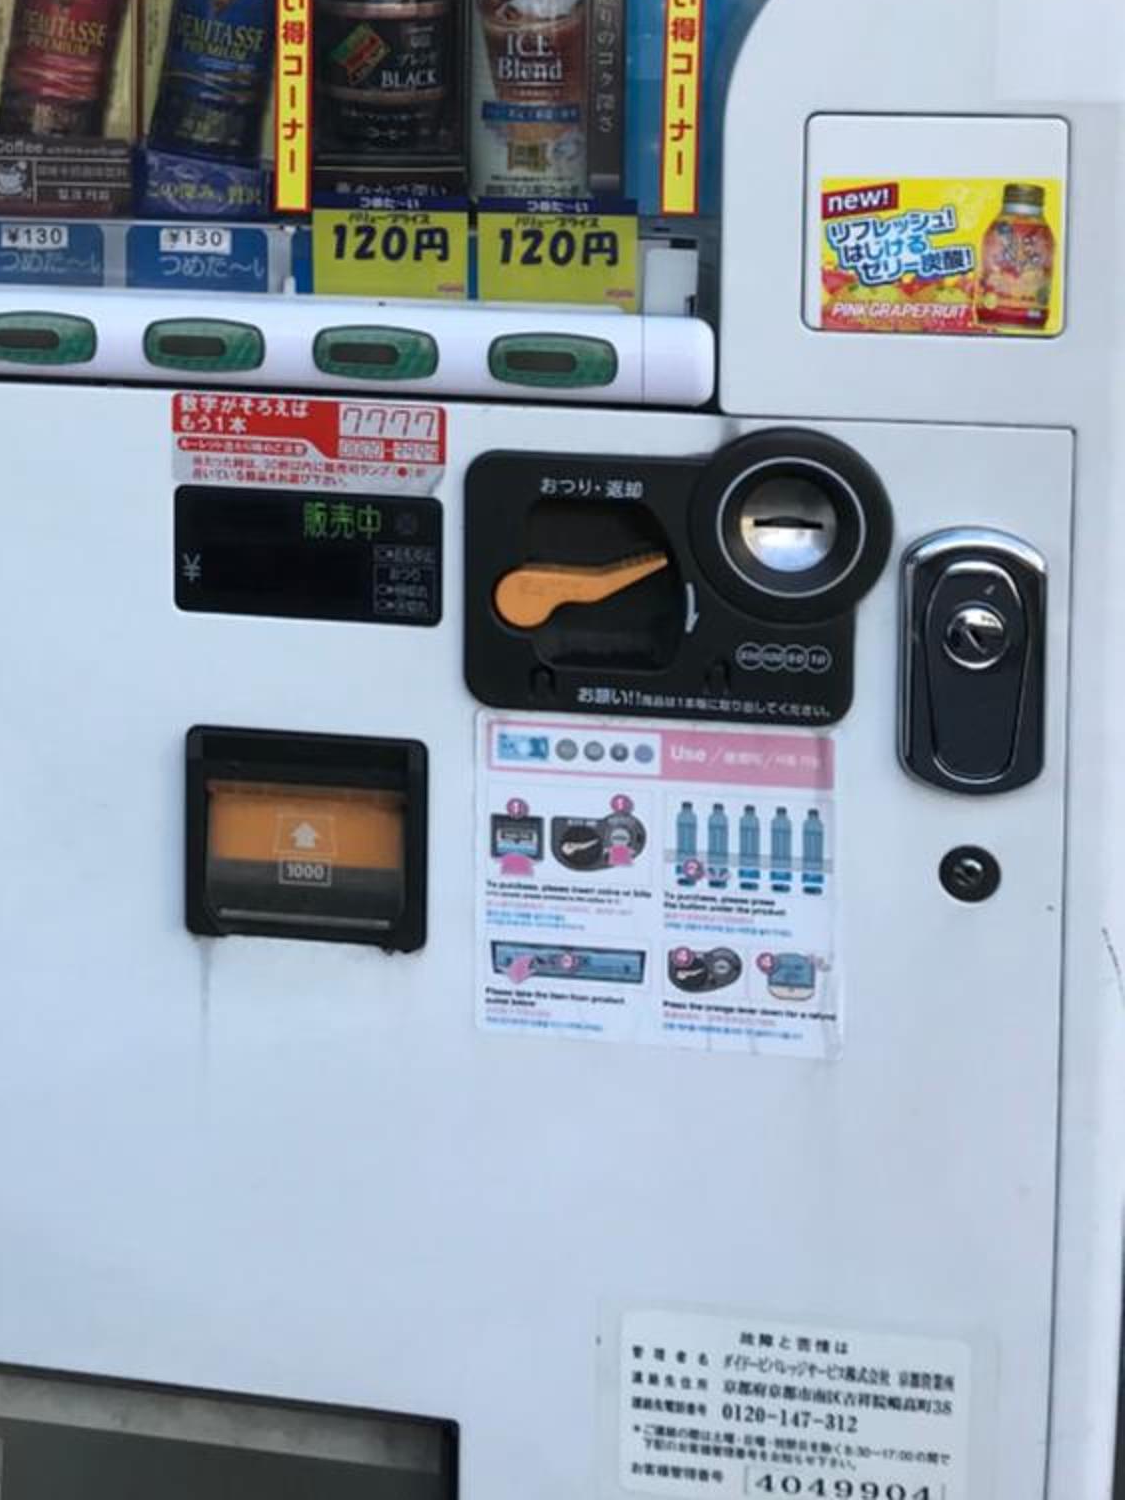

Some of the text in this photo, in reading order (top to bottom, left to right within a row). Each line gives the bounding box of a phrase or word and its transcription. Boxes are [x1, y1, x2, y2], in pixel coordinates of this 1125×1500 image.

[506, 32, 553, 58] ICE
[381, 69, 438, 88] BLACK
[497, 58, 564, 82] Blend
[827, 188, 891, 213] new!
[6, 226, 64, 246] ¥130
[829, 207, 957, 243] リフレッシュ!
[168, 228, 223, 249] ¥130
[332, 223, 450, 263] 120円
[499, 228, 619, 268] 120円
[842, 234, 927, 263] はじける
[861, 248, 973, 281] ゼリー炭酸!
[831, 303, 968, 319] PINK GRAPEFRUIT
[180, 394, 309, 419] 数字がそろえば
[180, 415, 247, 435] もう1本
[540, 476, 643, 500] おつり・返却
[303, 501, 382, 540] 販売中
[183, 552, 201, 582] ¥
[671, 747, 707, 764] Use
[285, 862, 325, 880] 1000
[721, 1401, 859, 1434] 0120-147-312
[753, 1473, 931, 1500] 4049904
